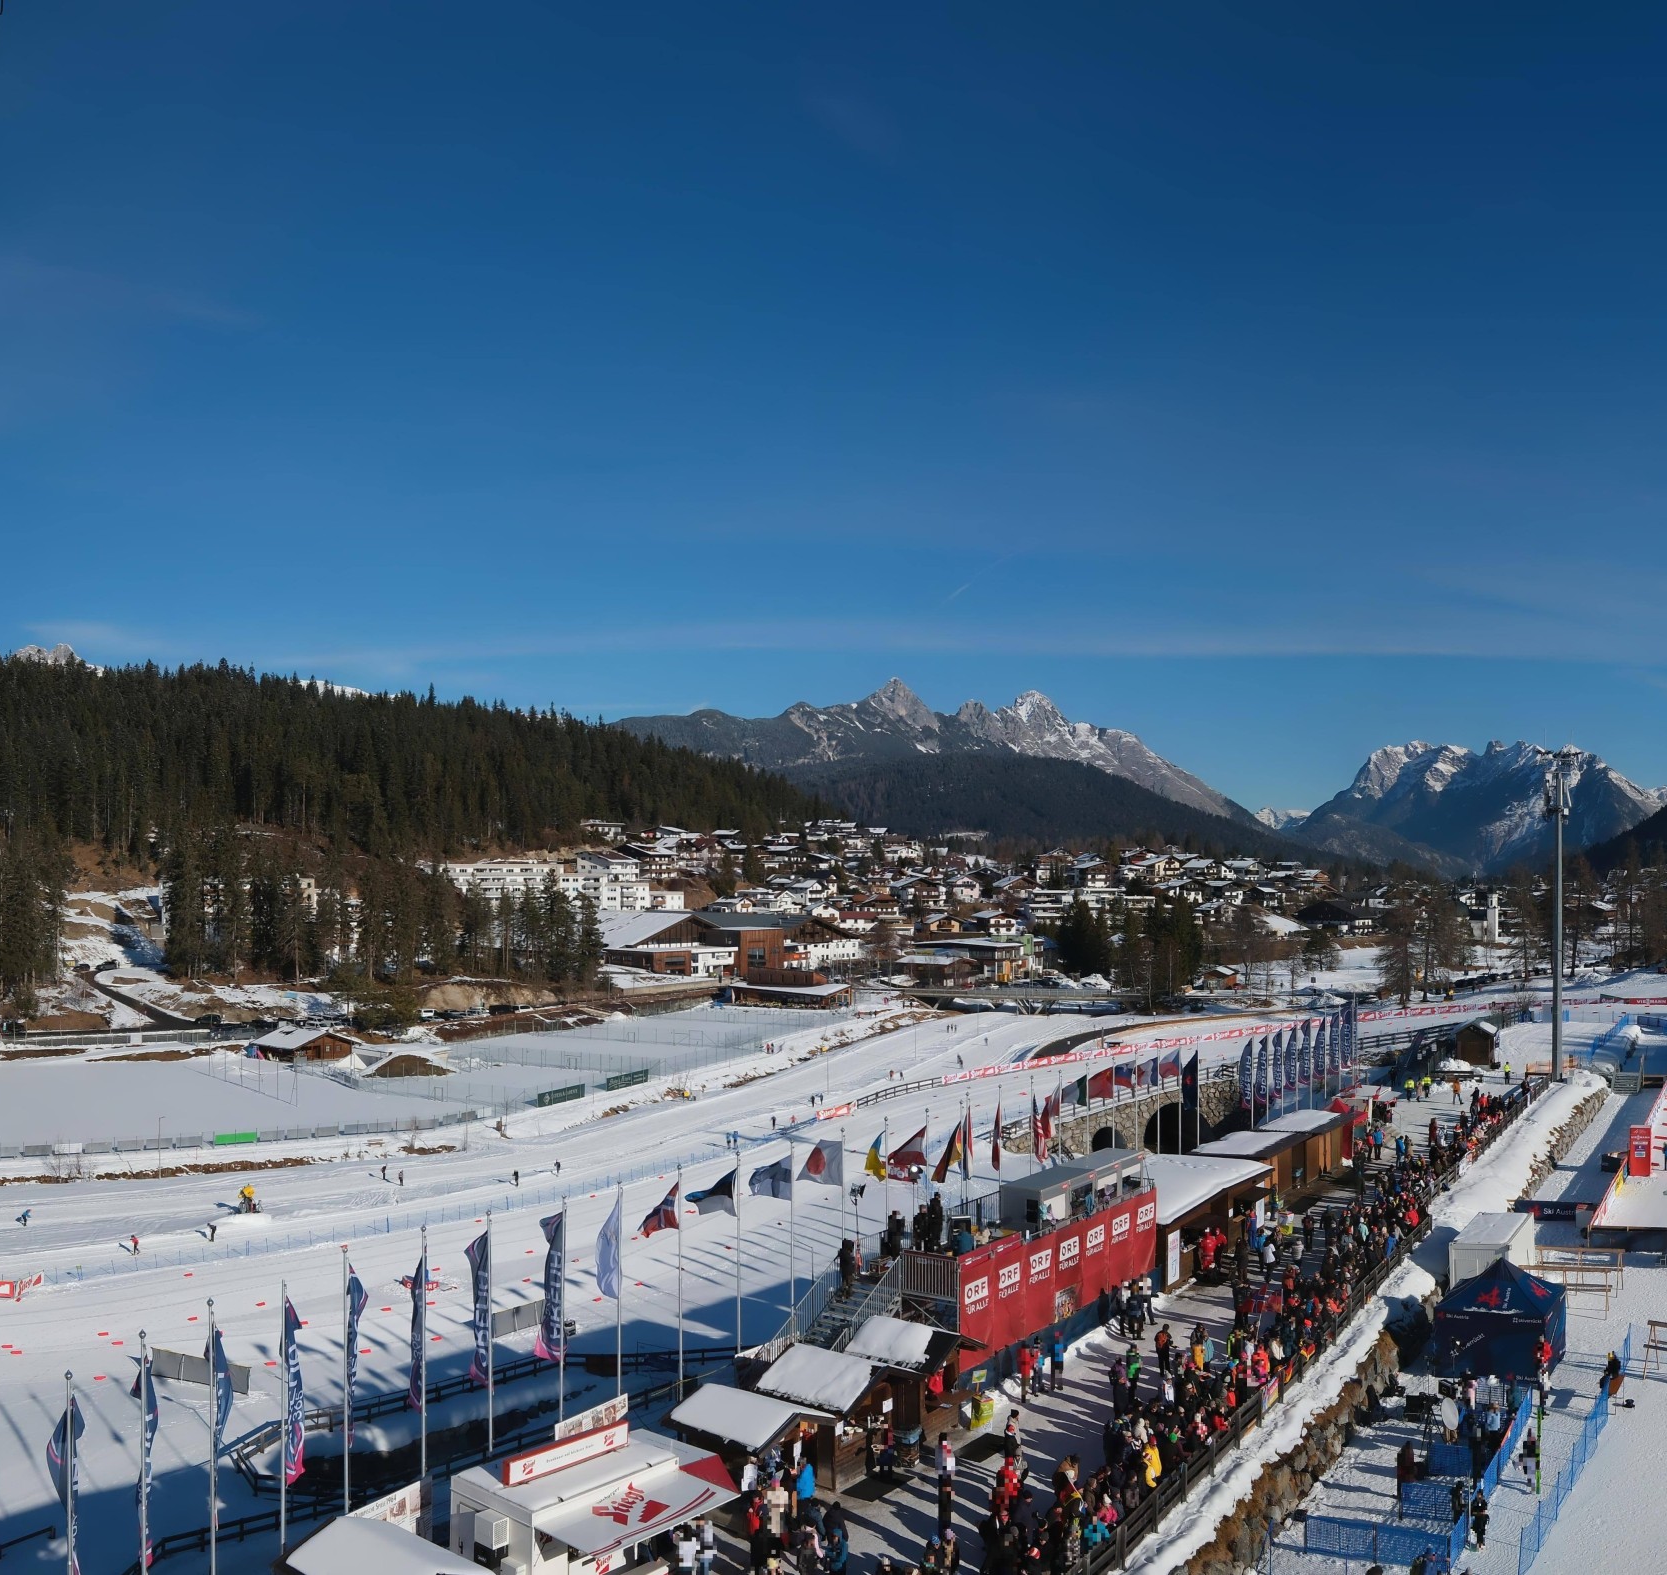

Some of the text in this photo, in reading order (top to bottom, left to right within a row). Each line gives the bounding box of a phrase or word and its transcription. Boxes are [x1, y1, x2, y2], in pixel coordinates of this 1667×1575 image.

[1138, 1205, 1153, 1220] ORF
[1113, 1217, 1128, 1231] ORF
[1088, 1228, 1103, 1243] ORF
[1061, 1240, 1077, 1256] ORF
[1031, 1253, 1050, 1270] ORF
[1000, 1266, 1018, 1284] ORF
[966, 1281, 987, 1299] ORF
[292, 1389, 304, 1421] 365
[592, 1481, 645, 1526] Stiegl
